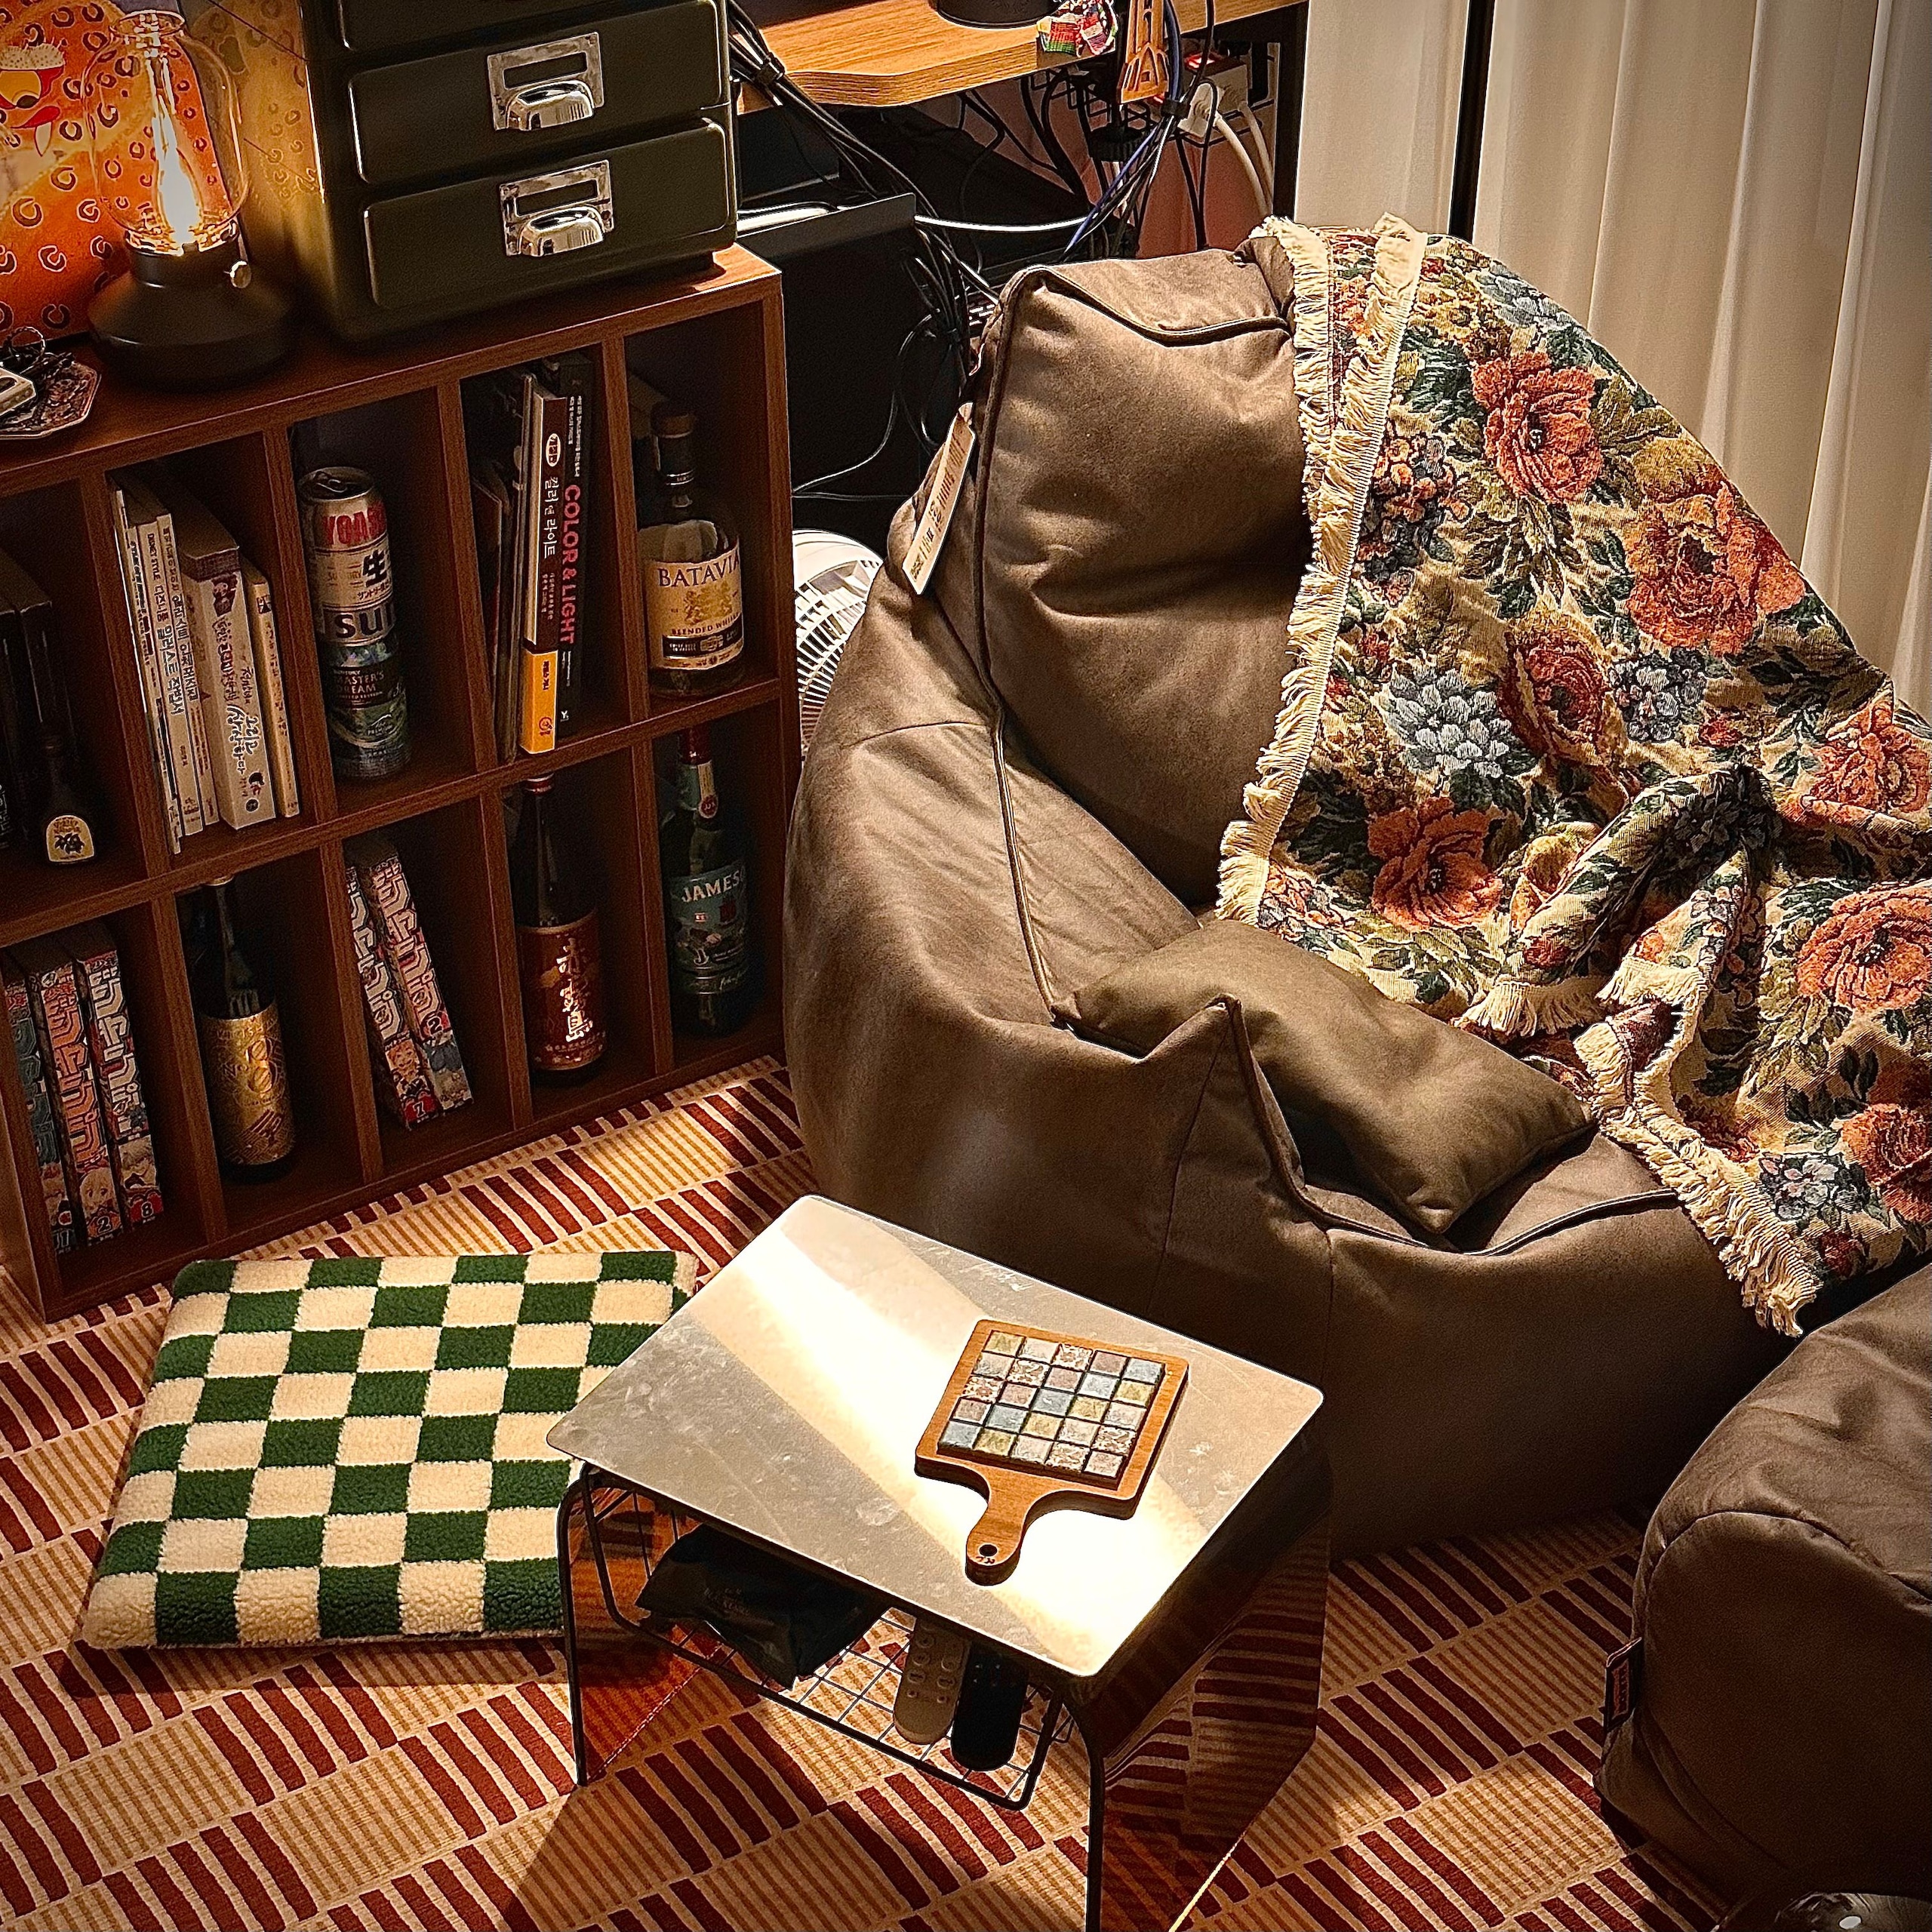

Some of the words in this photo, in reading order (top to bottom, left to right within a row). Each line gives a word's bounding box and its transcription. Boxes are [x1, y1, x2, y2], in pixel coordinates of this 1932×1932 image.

[545, 476, 559, 502] 컬러
[543, 518, 558, 558] 라이트
[562, 485, 581, 565] COLOR
[562, 568, 577, 580] &
[657, 549, 740, 587] BATAVIA
[560, 584, 577, 645] LIGHT
[671, 625, 713, 635] BLENDED
[157, 625, 178, 677] 일러스트
[427, 1017, 443, 1037] 2
[140, 1201, 154, 1218] 8
[97, 1215, 112, 1234] 2
